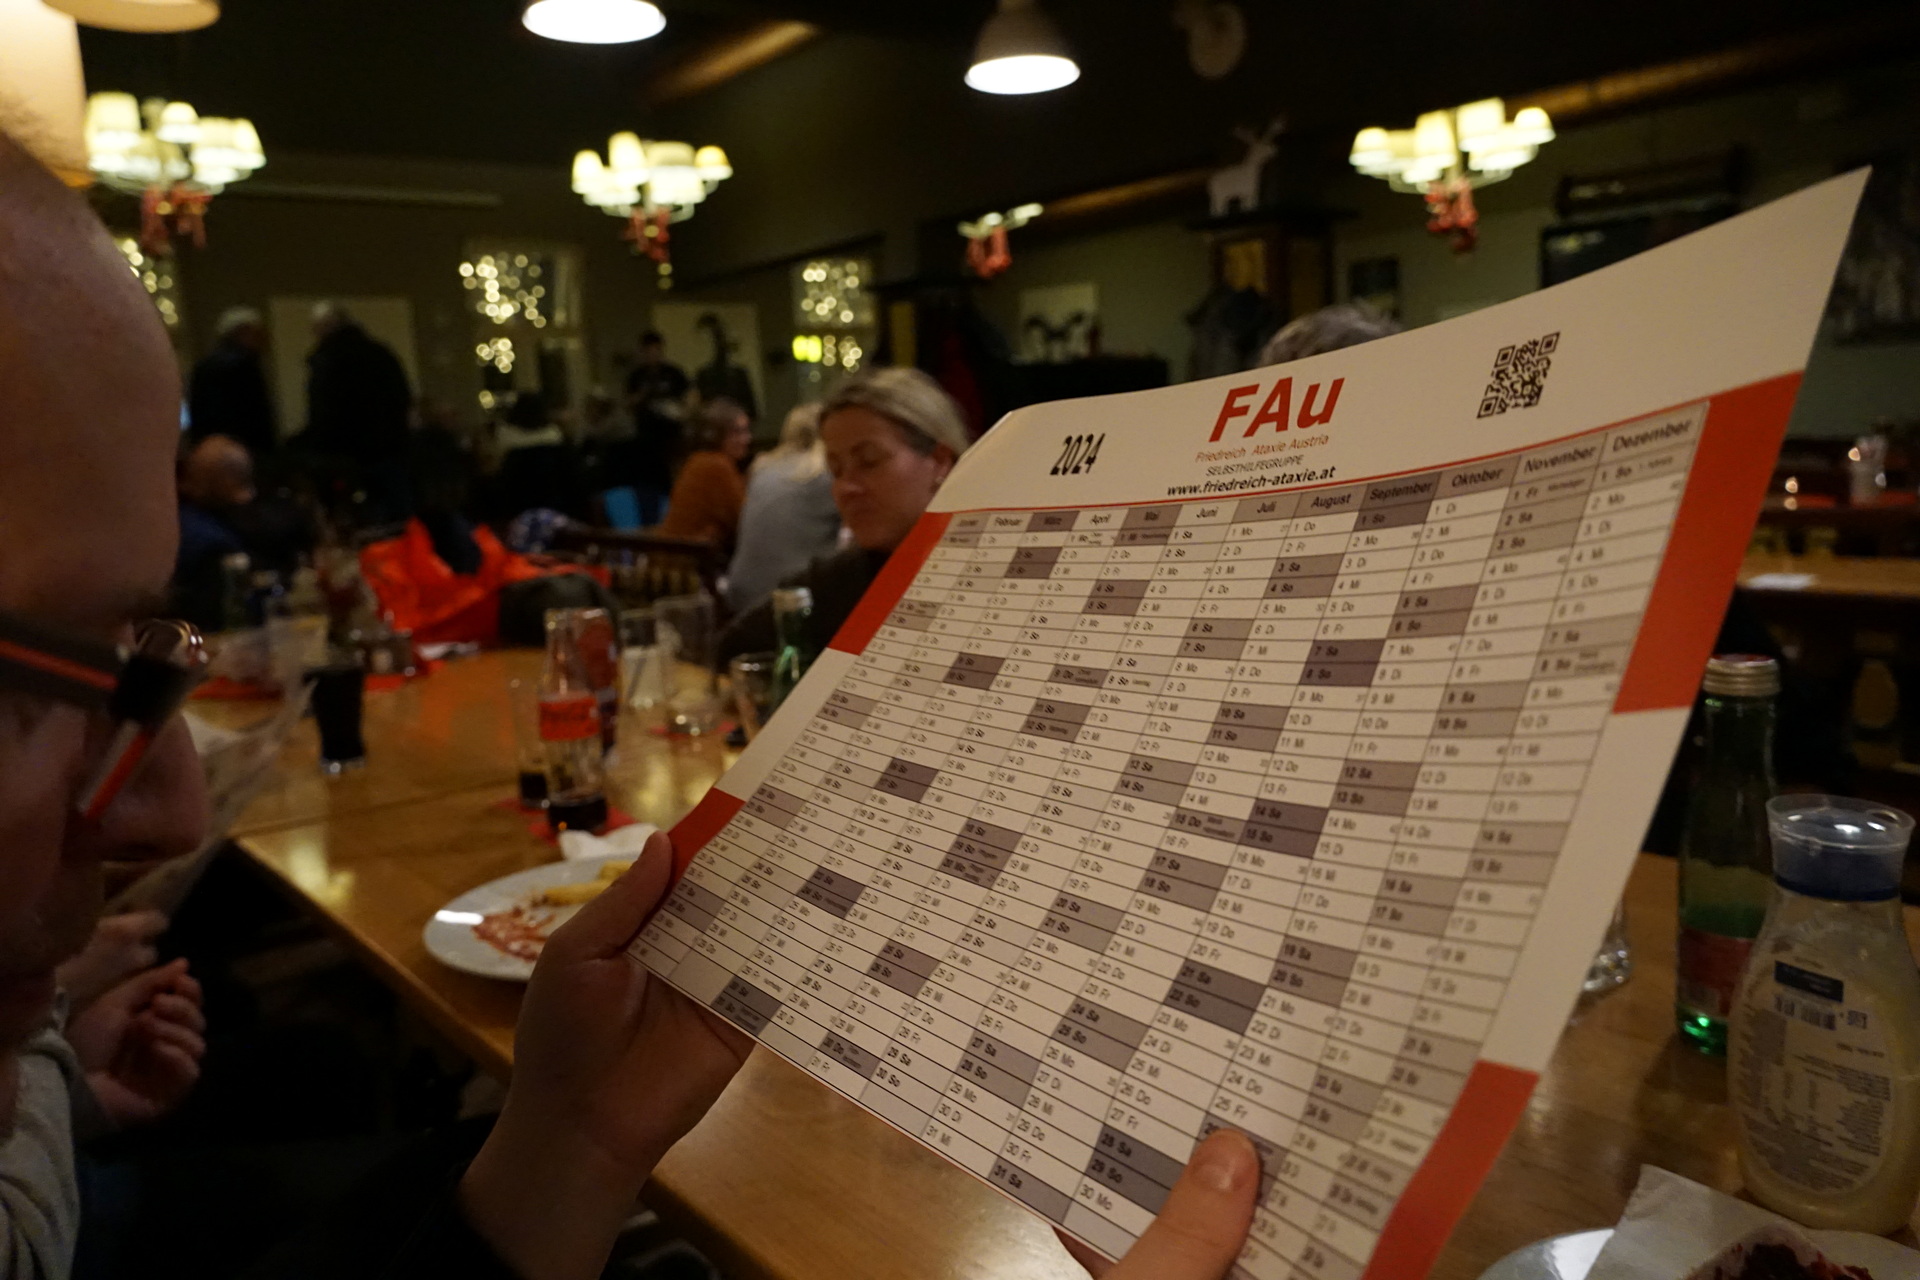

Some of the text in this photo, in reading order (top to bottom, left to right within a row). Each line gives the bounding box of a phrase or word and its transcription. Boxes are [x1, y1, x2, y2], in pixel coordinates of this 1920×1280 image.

[1209, 376, 1345, 443] FAu
[1612, 418, 1692, 452] Dezember
[1050, 433, 1106, 476] 2024
[1195, 434, 1329, 463] Friedreich Ataxie Austria
[1523, 446, 1596, 473] November
[1206, 454, 1305, 477] SELBSTHILFEGRUPPE
[1167, 466, 1336, 497] www.friedreich-ataxie.at
[1452, 467, 1503, 488] Oktober
[1311, 494, 1352, 509] August
[1369, 481, 1433, 500] September
[1196, 508, 1218, 519] Juni
[1257, 502, 1277, 514] Juli
[1089, 514, 1112, 526] April
[1121, 918, 1146, 935] 20 Di
[1110, 940, 1136, 958] 21 Mi
[1192, 943, 1222, 961] 20 Fr
[1096, 961, 1126, 980] 22 Do
[1180, 965, 1212, 985] 21 Sa
[1084, 982, 1111, 1001] 23 Fr
[1169, 988, 1201, 1009] 22 So
[1071, 1003, 1100, 1023] 24 Sa
[1262, 994, 1295, 1016] 21 Mo
[1155, 1011, 1189, 1033] 23 Mo
[1250, 1020, 1282, 1040] 22 Di
[1057, 1024, 1087, 1045] 25 So
[1144, 1034, 1172, 1054] 24 Di
[1060, 1053, 1076, 1069] Mo
[1238, 1044, 1272, 1067] 23 Mi
[1130, 1057, 1160, 1079] 25 Mi
[1035, 1070, 1062, 1091] 27 Di
[1226, 1070, 1263, 1096] 24 Do
[1026, 1094, 1054, 1116] 28 Mi
[1135, 1089, 1152, 1106] Do
[1214, 1096, 1248, 1119] 25 Fr
[1109, 1107, 1139, 1130] 27 Fr
[1016, 1118, 1046, 1142] 29 Do
[1004, 1141, 1032, 1163] 30 Fr
[1100, 1133, 1133, 1158] 28 Sa
[993, 1164, 1023, 1189] 31 Sa
[1090, 1158, 1123, 1184] 29 So
[1079, 1183, 1113, 1211] 30 Mo
